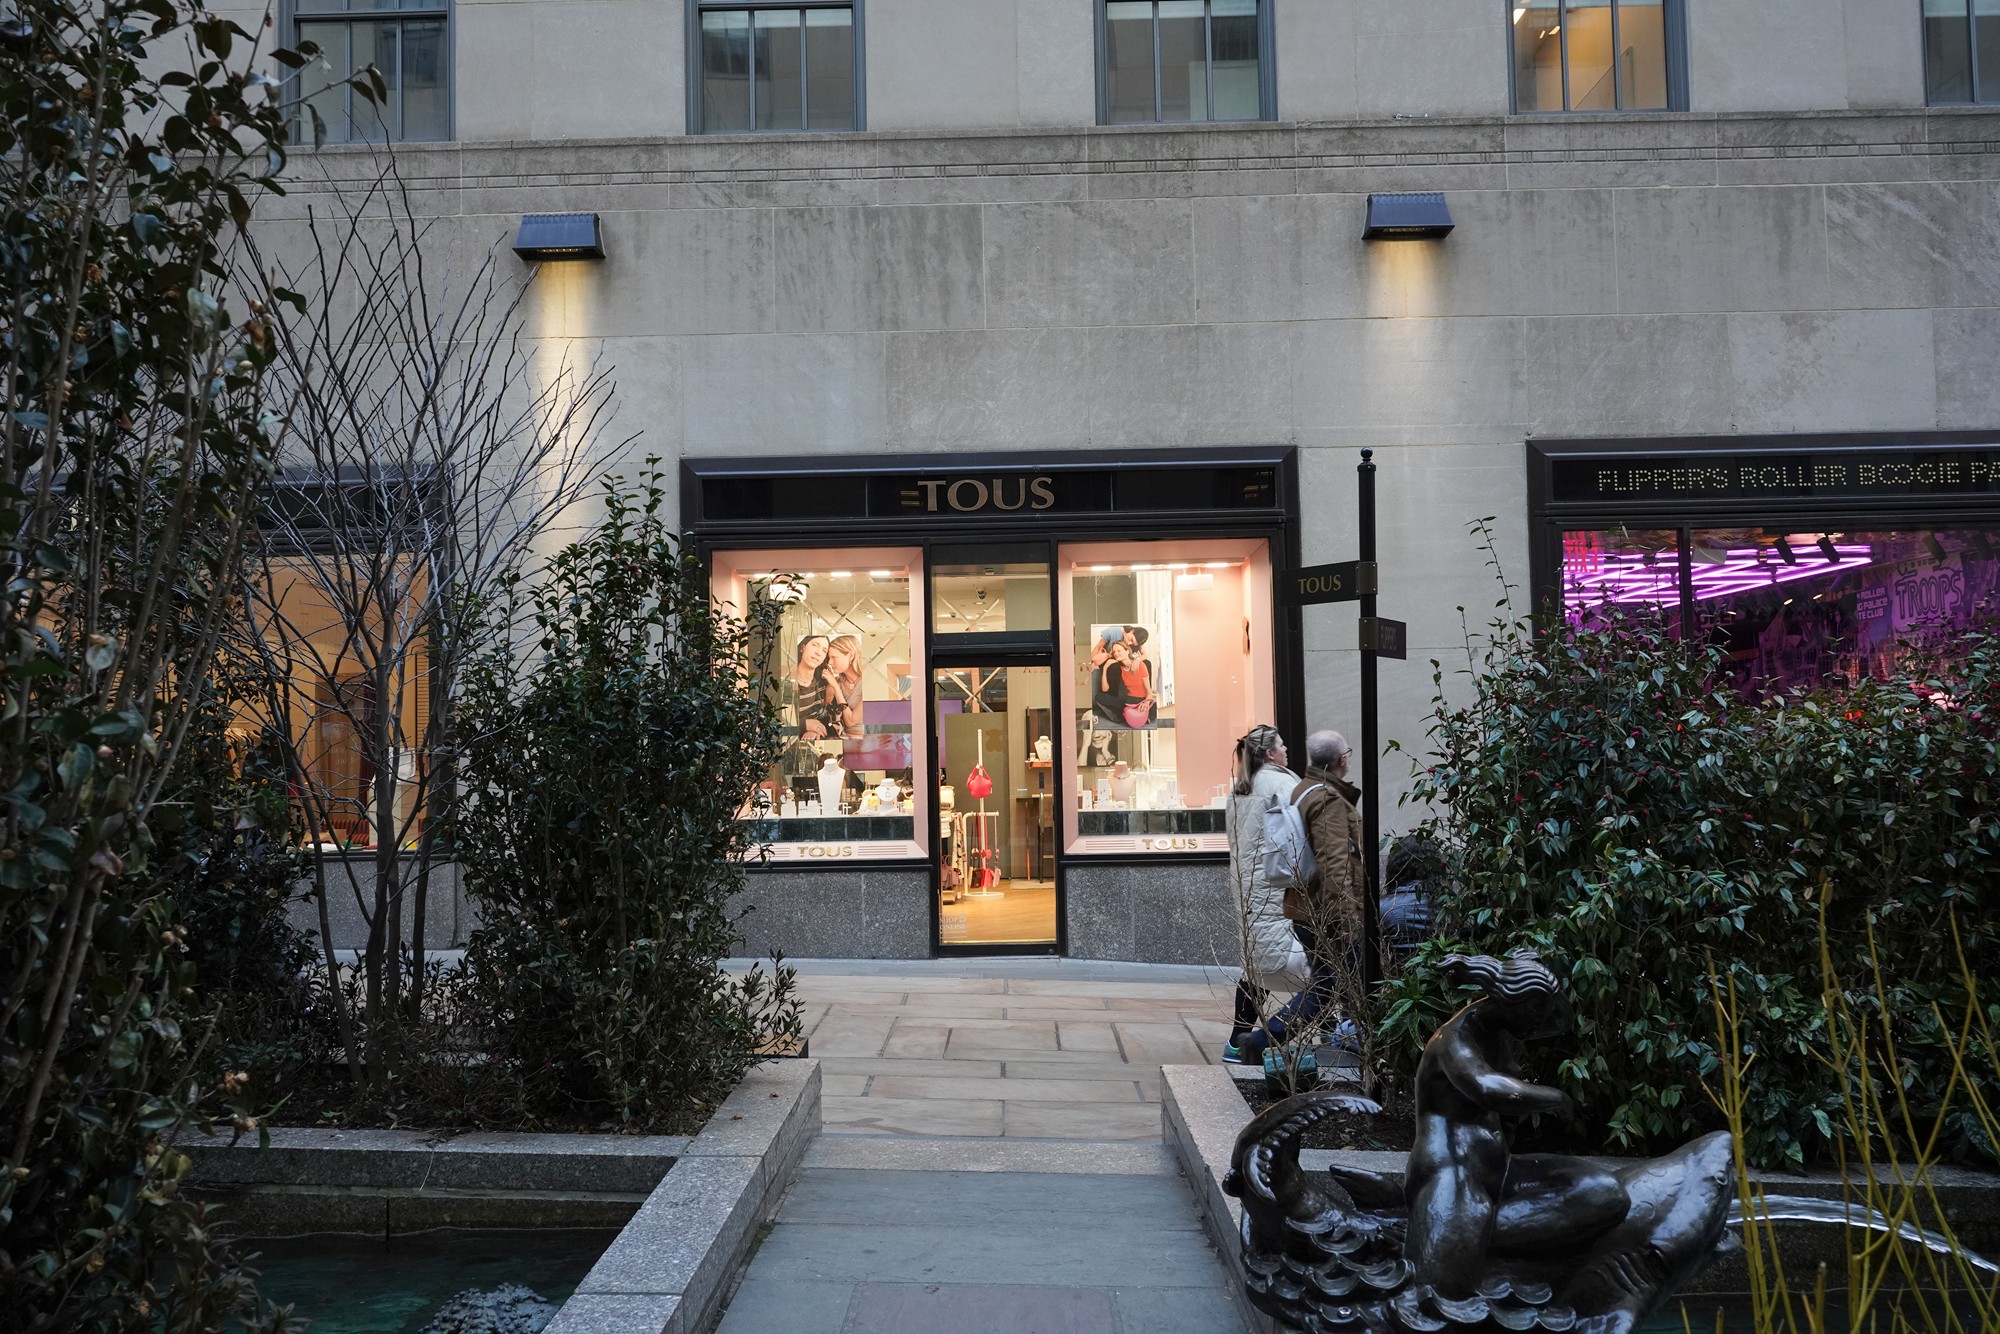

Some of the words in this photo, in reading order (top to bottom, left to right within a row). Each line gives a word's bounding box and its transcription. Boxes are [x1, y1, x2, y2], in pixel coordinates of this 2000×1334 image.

[1598, 468, 1728, 491] FLIPPER'S
[1741, 465, 1847, 488] ROLLER
[1859, 462, 1960, 485] BOOGIE
[917, 477, 1055, 512] TOUS
[1297, 574, 1342, 595] TOUS
[797, 846, 853, 858] TOUS
[1141, 838, 1198, 850] TOUS
